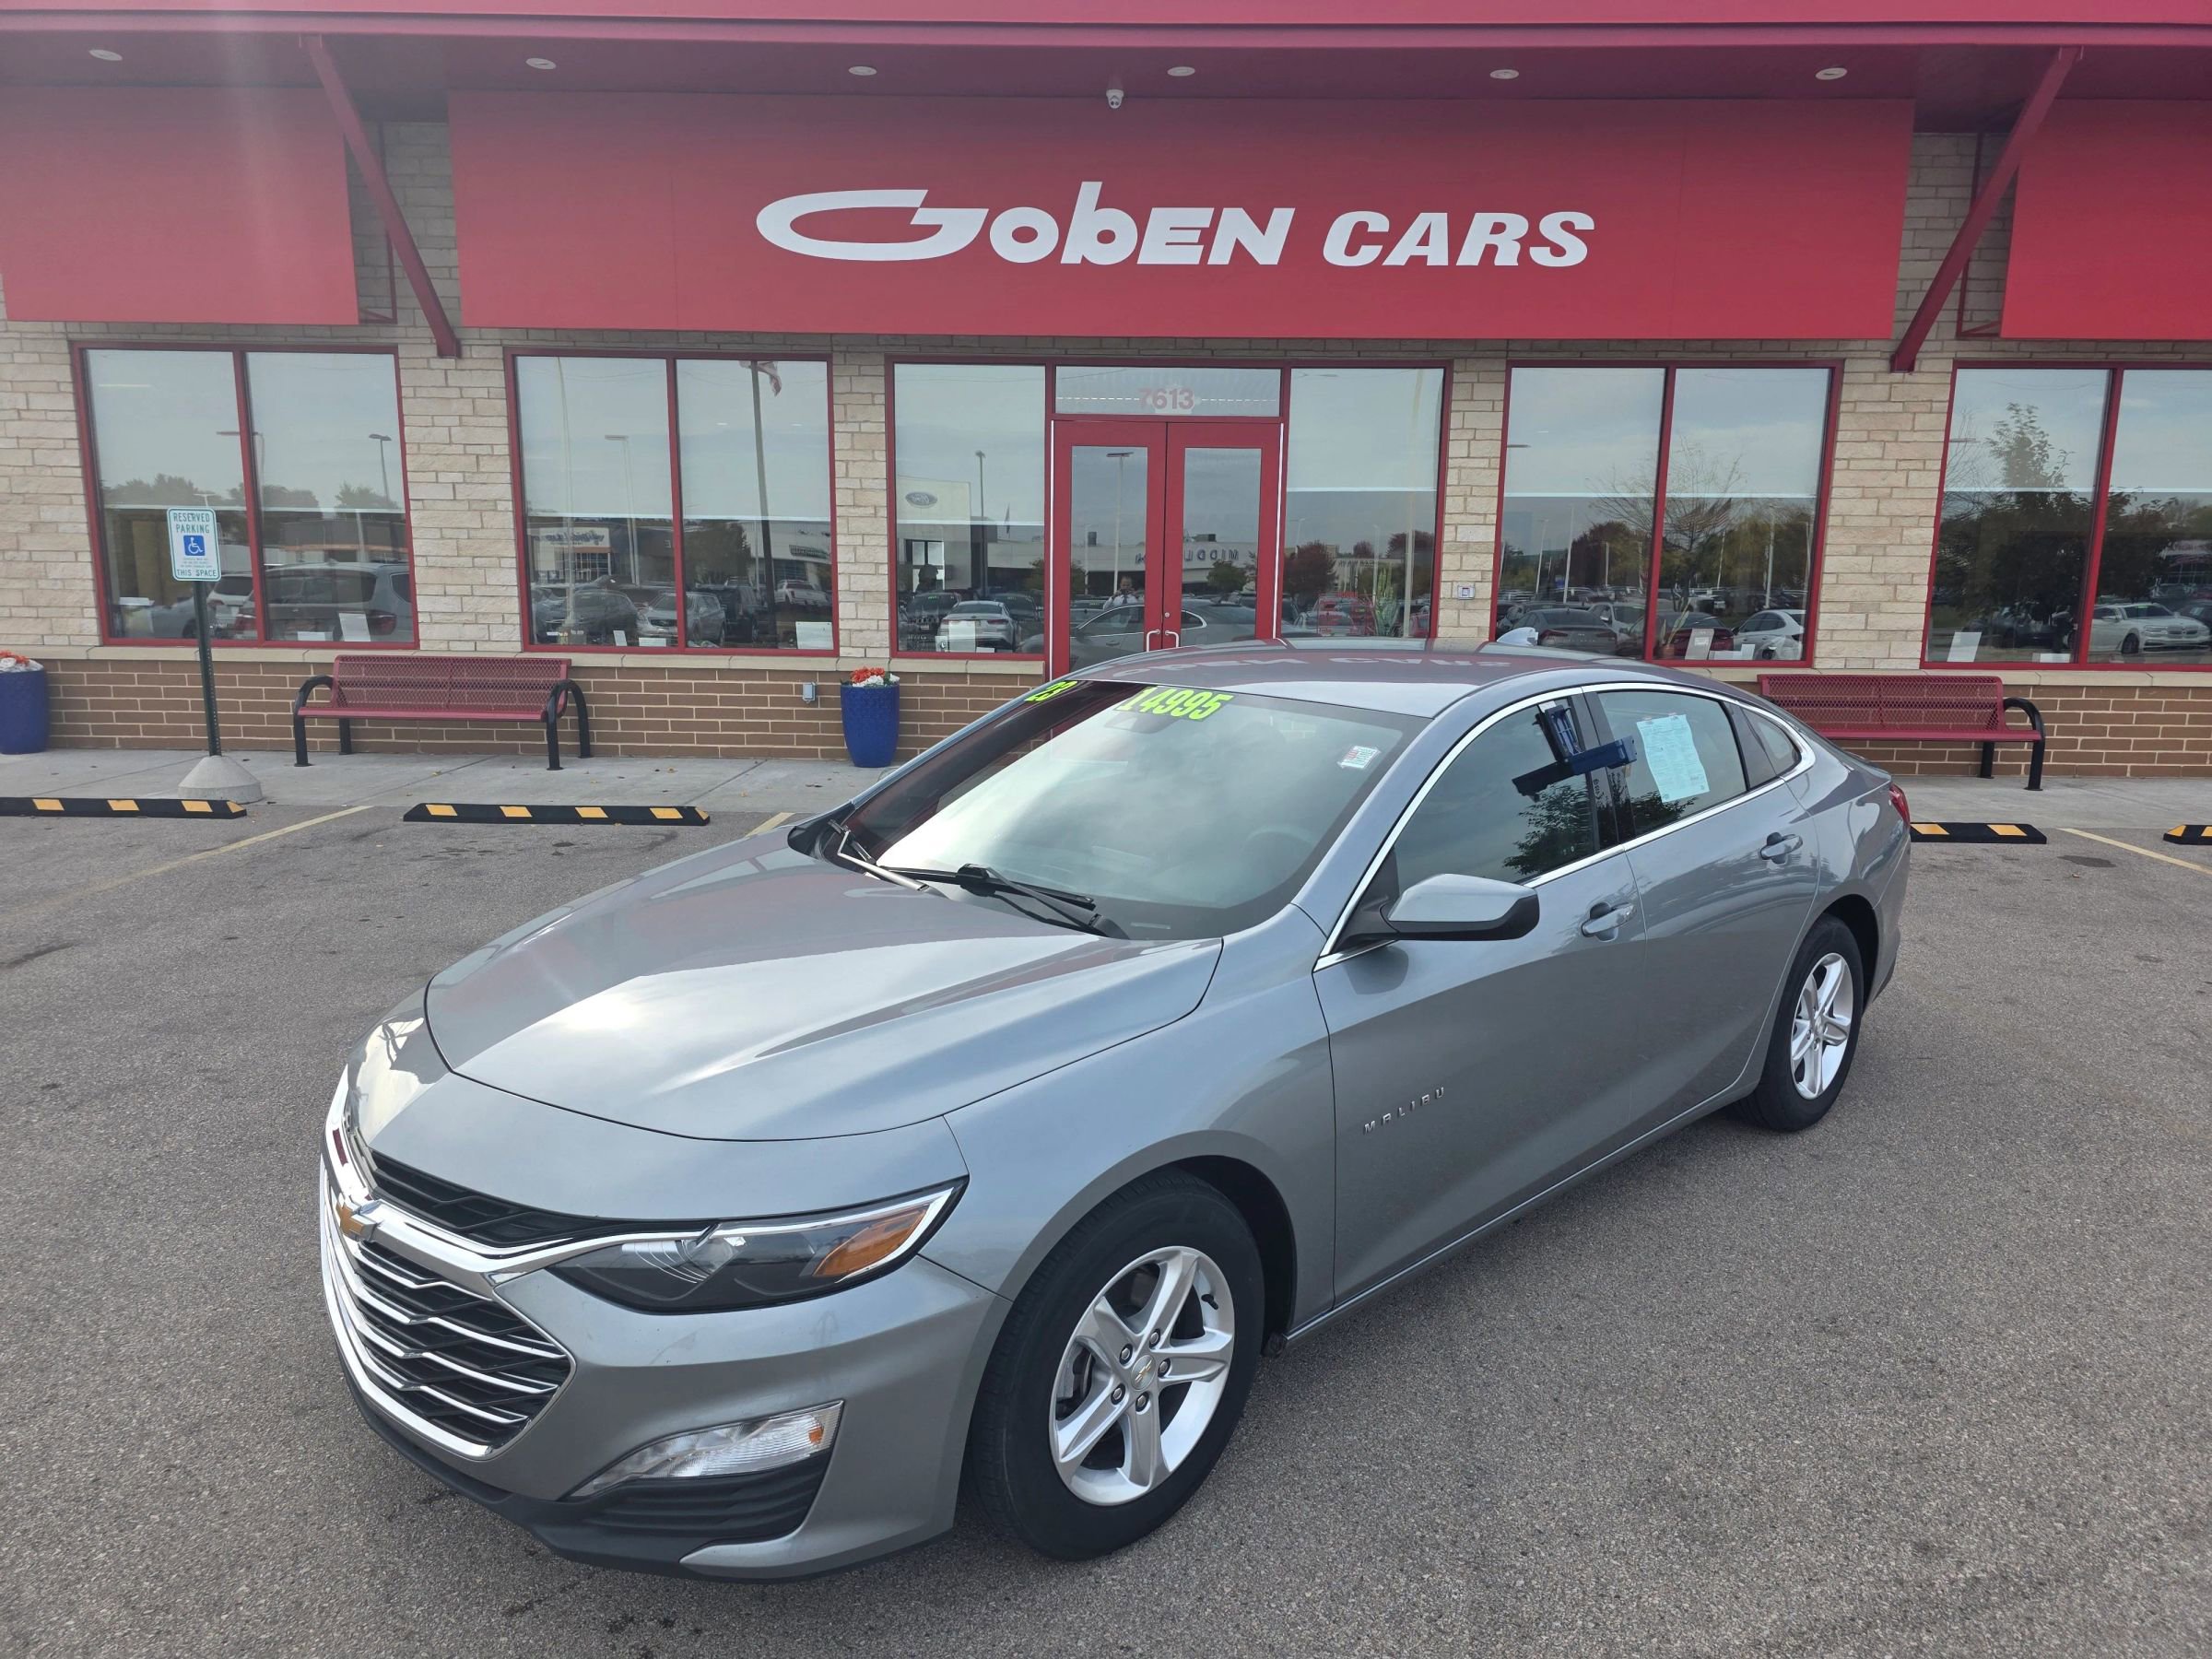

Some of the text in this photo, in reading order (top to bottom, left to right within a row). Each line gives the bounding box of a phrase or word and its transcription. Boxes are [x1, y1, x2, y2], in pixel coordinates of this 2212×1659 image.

[1322, 209, 1596, 267] CARS
[1135, 387, 1195, 410] 7613
[173, 512, 211, 523] RESERVED
[176, 524, 210, 534] PARKING
[177, 569, 217, 577] THIS SPACE
[1114, 685, 1234, 720] 14995
[1364, 1087, 1444, 1134] MALIBU
